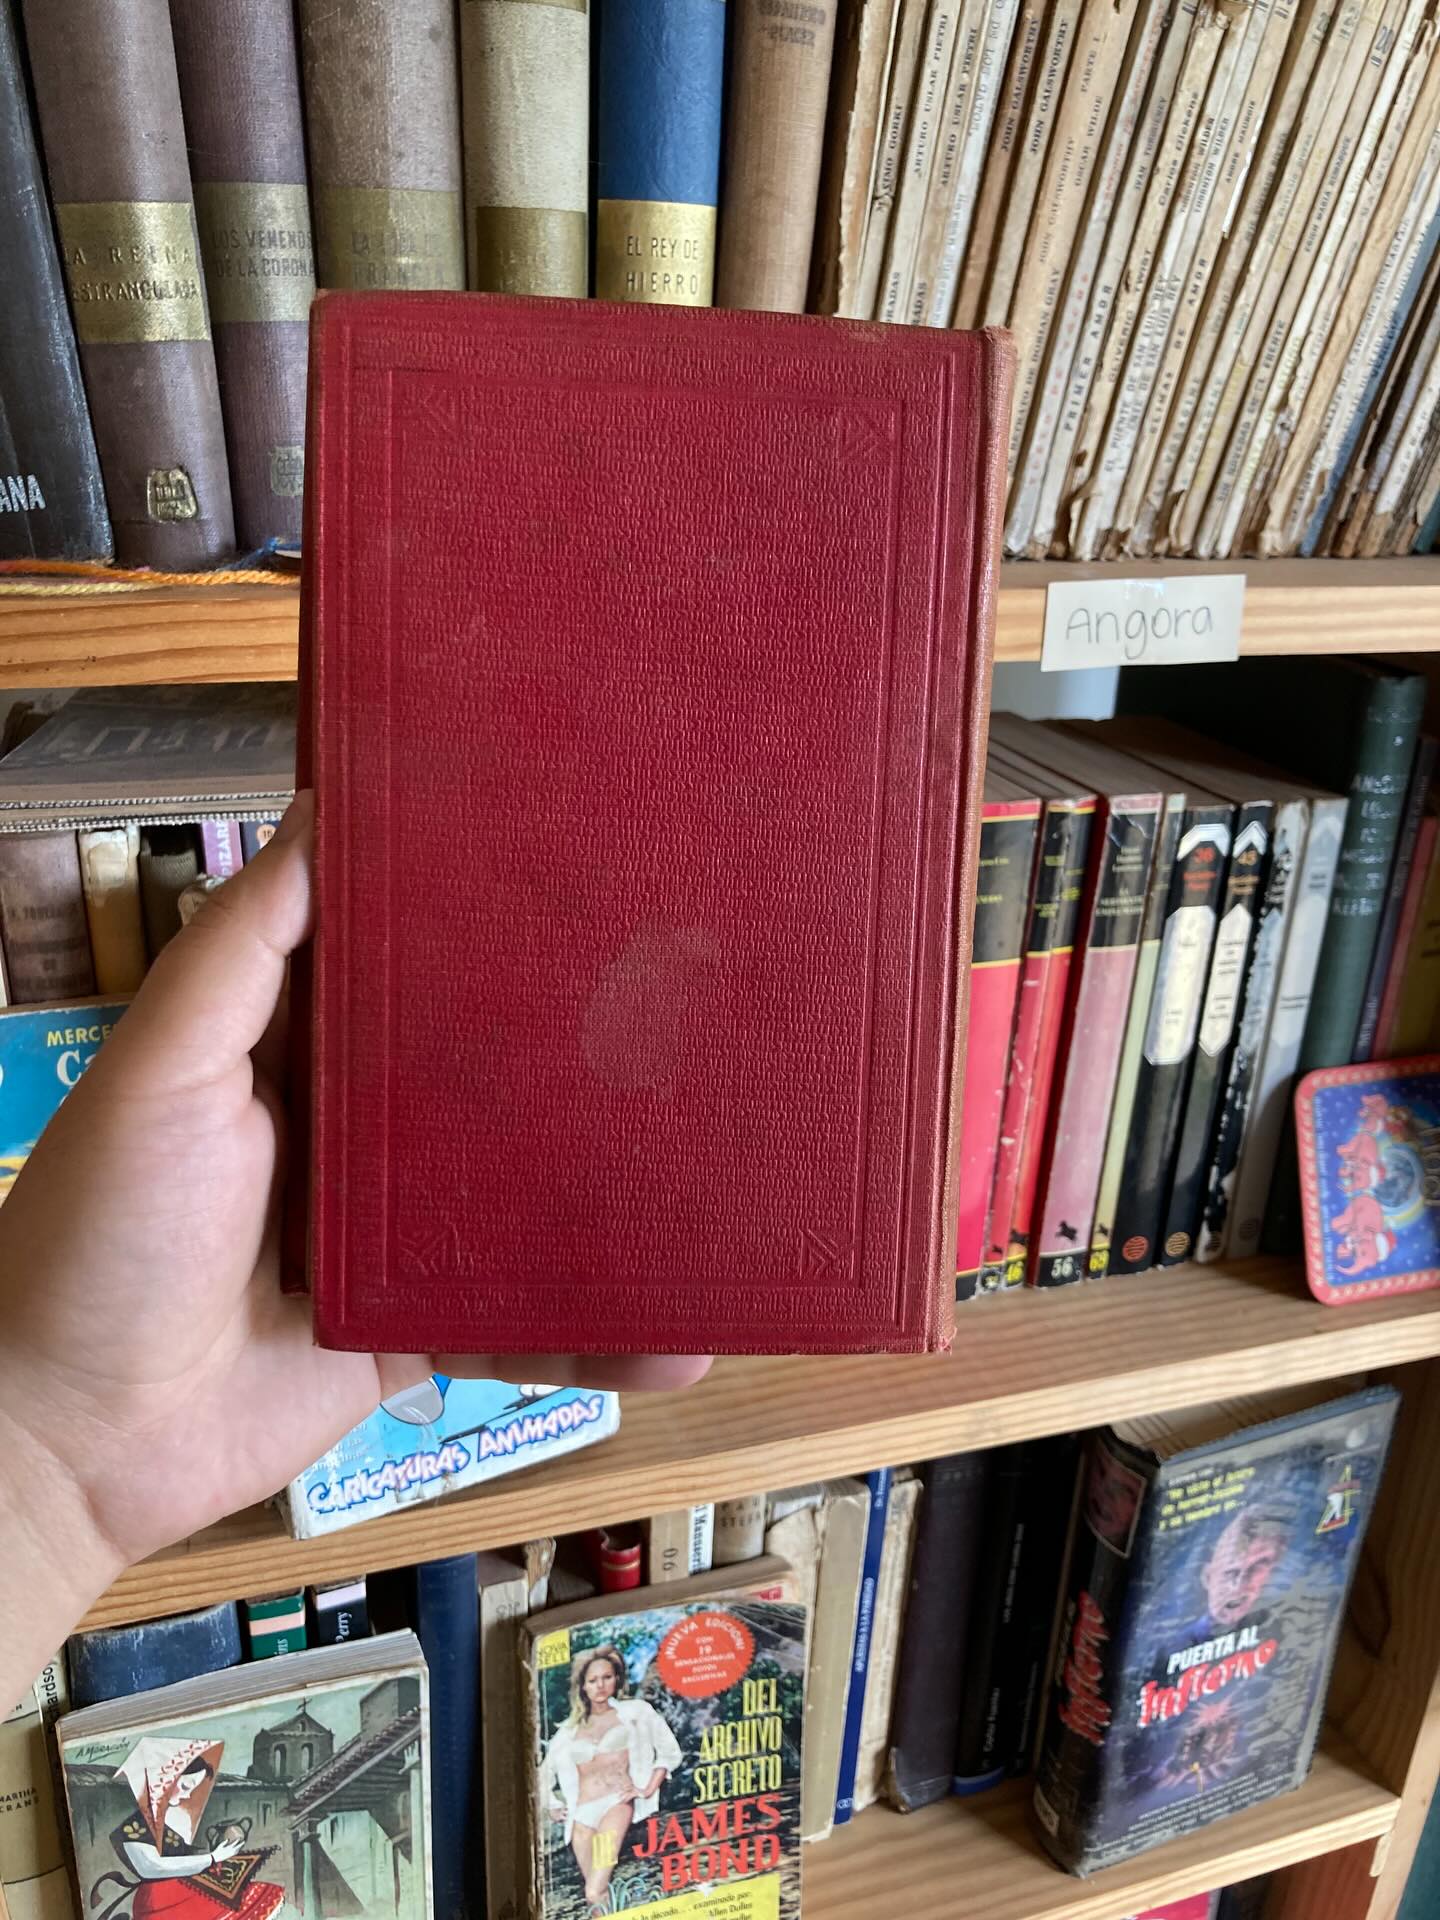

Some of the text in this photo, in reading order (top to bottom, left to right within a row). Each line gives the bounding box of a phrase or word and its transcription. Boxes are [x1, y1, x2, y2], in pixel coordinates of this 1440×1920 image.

[913, 13, 948, 176] ARTURO USLAR PIETRI
[1000, 15, 1039, 152] JOHN GALSWORTHY
[1030, 16, 1068, 155] JOHN GALSWORTHY
[1080, 49, 1097, 93] PARTE
[888, 104, 903, 149] GORKI
[941, 134, 957, 187] ARTURO
[952, 83, 967, 126] USLAR
[1074, 95, 1103, 187] OSCAR WILDE
[627, 236, 699, 260] EL REY DE
[627, 273, 699, 294] HIERRO
[1187, 257, 1207, 306] AMOR
[1064, 284, 1112, 432] PRIMER AMOR
[1126, 376, 1136, 391] DE
[1134, 345, 1146, 368] SAN
[1066, 605, 1213, 660] Angora
[1051, 1256, 1074, 1278] 56
[306, 1441, 471, 1515] CARICATURAS
[477, 1394, 605, 1462] ANIMADAS
[1167, 1625, 1261, 1674] PUERTA AL
[743, 1679, 782, 1716] DEL
[700, 1716, 782, 1764] ARCHIVO
[693, 1755, 782, 1803] SECRETO
[632, 1793, 782, 1857] JAMES
[662, 1834, 780, 1892] BOND
